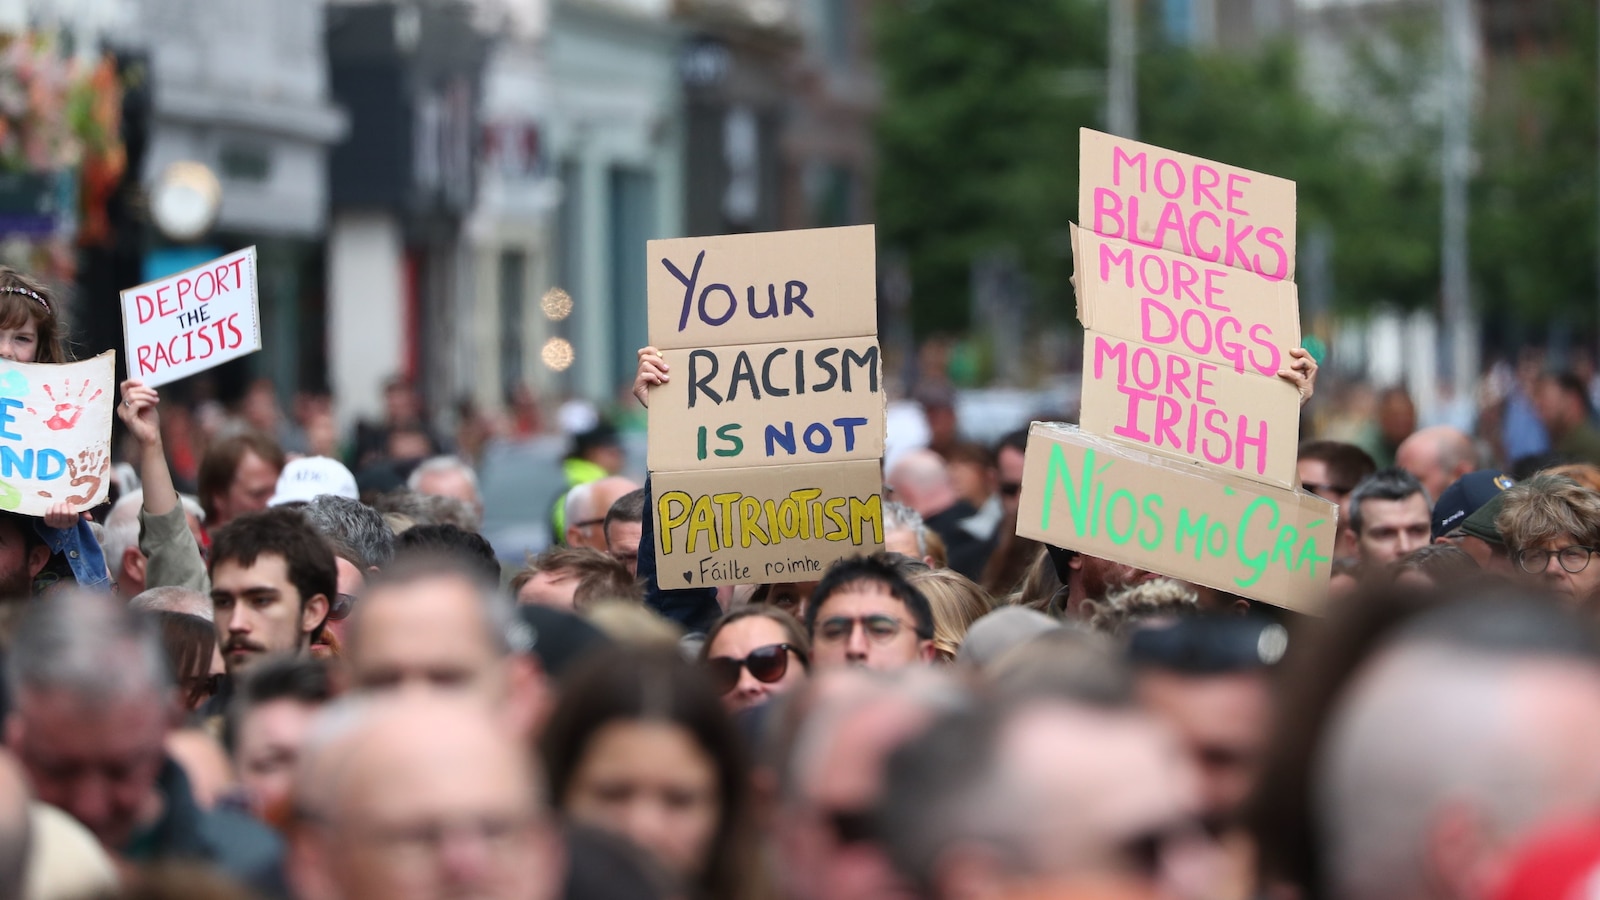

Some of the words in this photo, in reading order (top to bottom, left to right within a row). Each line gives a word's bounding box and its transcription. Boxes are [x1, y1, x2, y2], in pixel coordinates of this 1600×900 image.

[1113, 146, 1251, 216] MORE
[1093, 187, 1288, 282] BLACKS
[135, 257, 246, 325] DEPORT
[1099, 243, 1231, 313] MORE
[137, 313, 243, 377] RACISTS
[176, 304, 211, 330] THE
[1141, 297, 1281, 377] DOGS
[687, 345, 879, 409] RACISM
[1093, 336, 1218, 405] MORE
[697, 423, 744, 460] IS
[765, 417, 868, 457] NOT
[1113, 384, 1268, 475] IRISH
[658, 487, 885, 555] PATRIOTISM
[699, 556, 751, 584] Fáilte
[765, 556, 822, 577] roimhe
